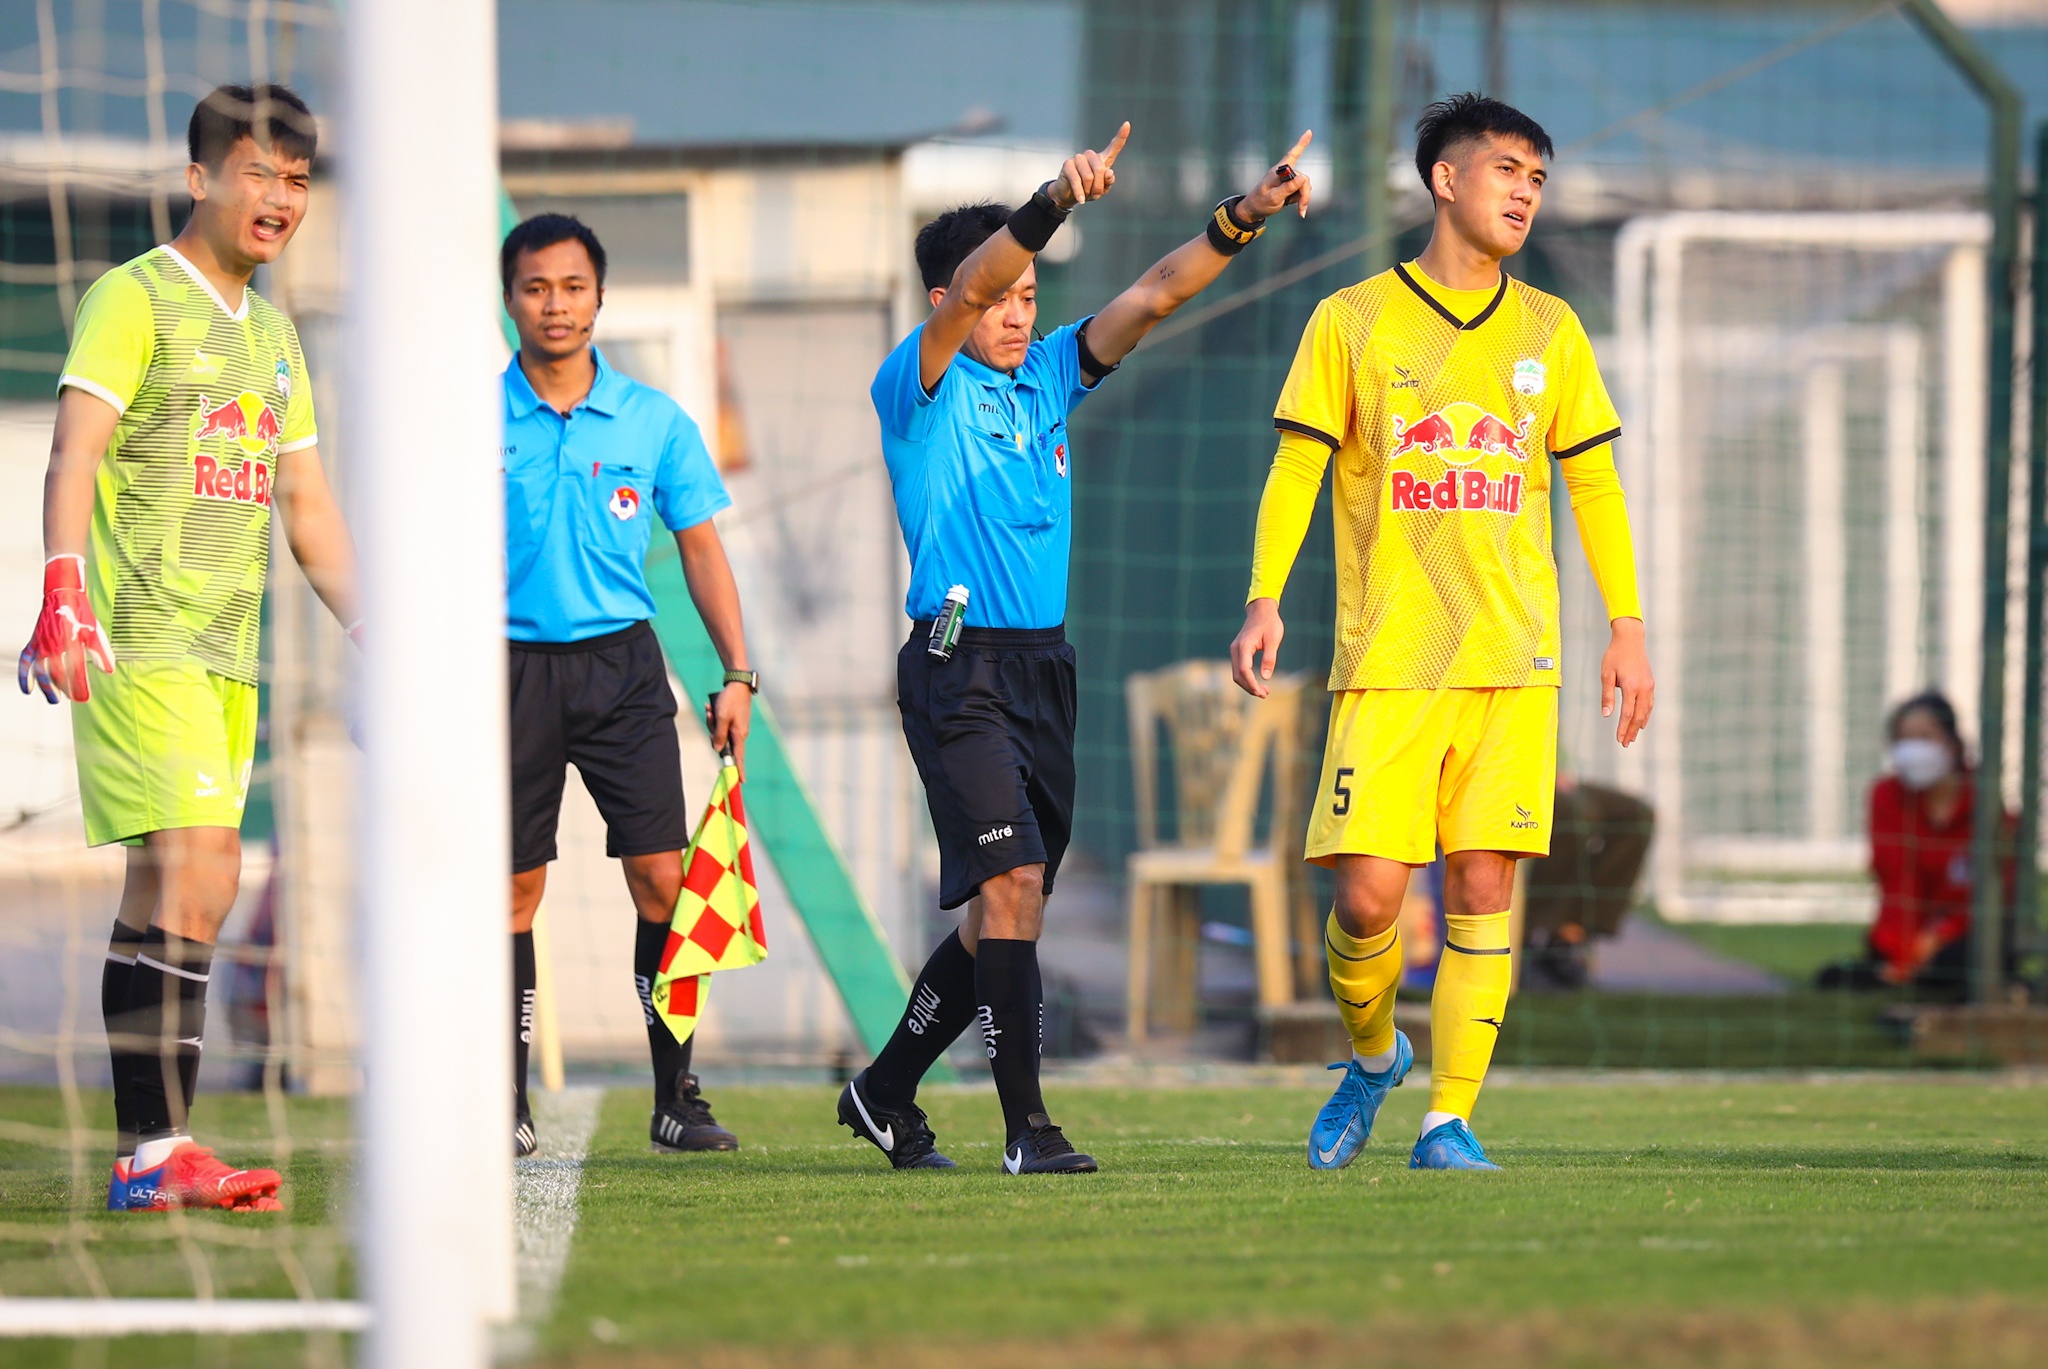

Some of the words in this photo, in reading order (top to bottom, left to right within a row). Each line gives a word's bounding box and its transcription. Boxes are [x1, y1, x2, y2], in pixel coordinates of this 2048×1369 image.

[1391, 380, 1420, 389] KAMITO
[194, 455, 253, 502] Red
[1392, 470, 1458, 510] Red
[1461, 471, 1522, 514] Bull
[1333, 767, 1355, 816] 5
[978, 825, 1013, 846] mitre
[1511, 820, 1539, 829] KAMITO
[908, 982, 942, 1036] mitre
[977, 1004, 1003, 1060] mitre
[129, 1186, 179, 1204] ULTRA
